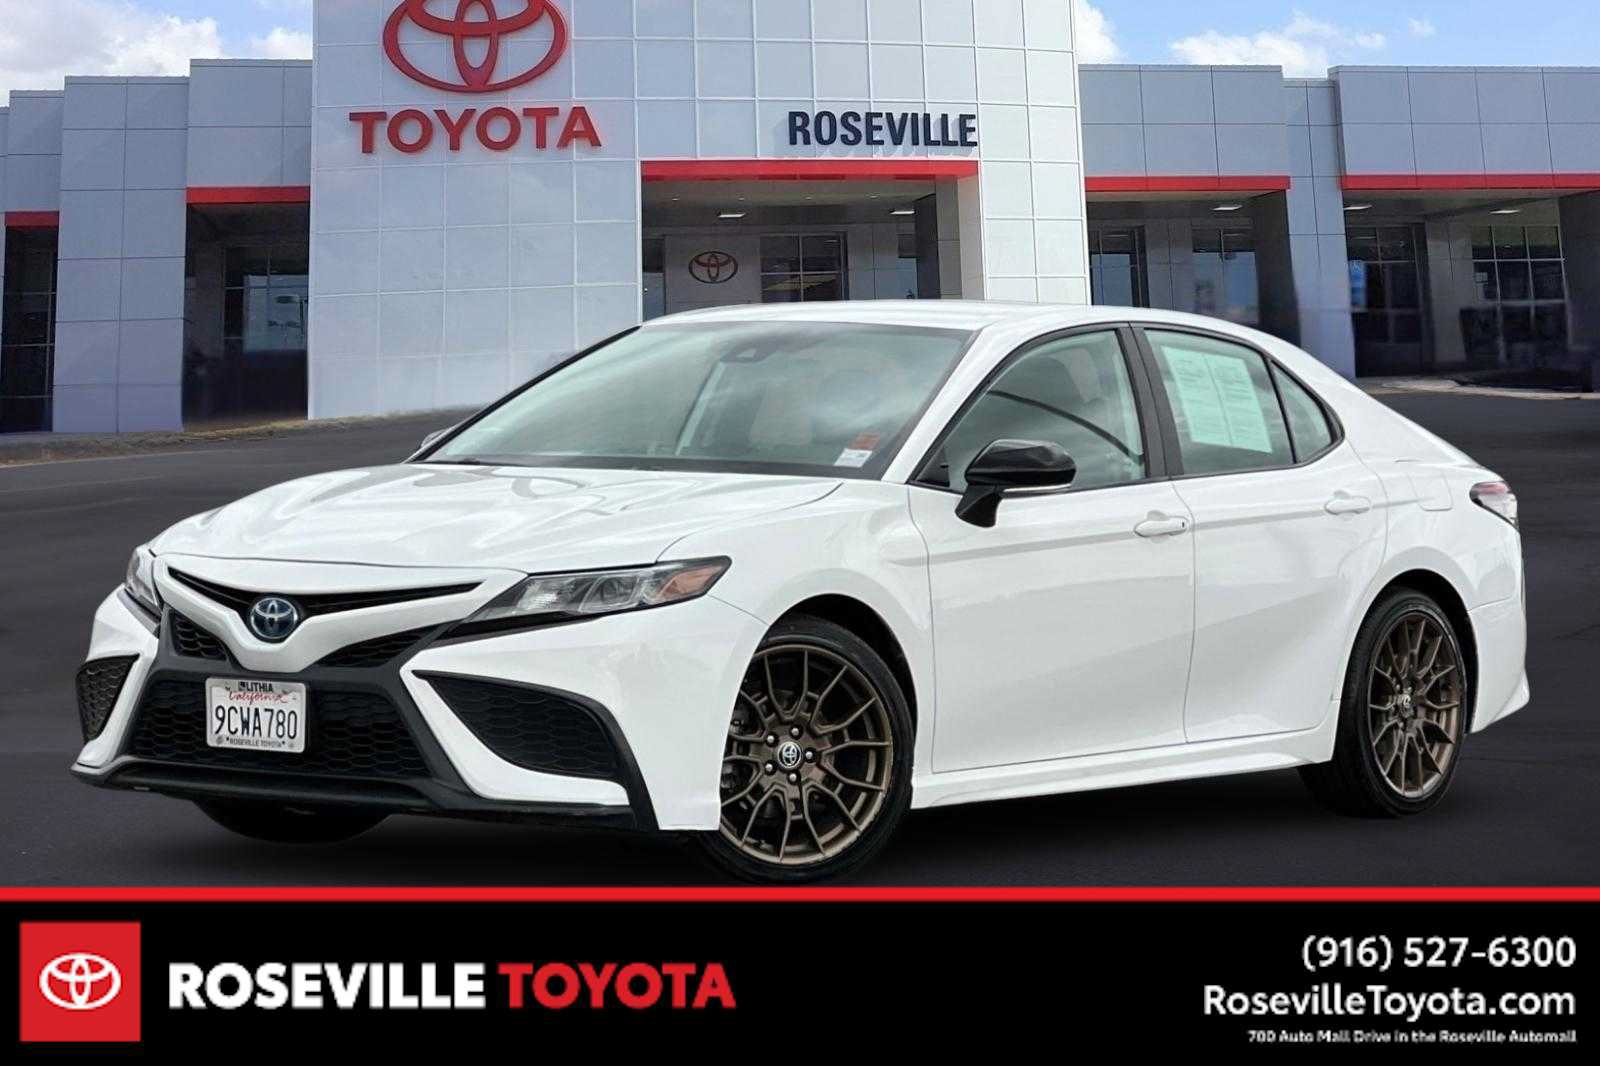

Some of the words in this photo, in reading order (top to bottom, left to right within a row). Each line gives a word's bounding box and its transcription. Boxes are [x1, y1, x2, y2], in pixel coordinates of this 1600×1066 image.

[349, 106, 602, 154] TOYOTA
[788, 110, 978, 147] ROSEVILLE
[229, 691, 289, 705] California
[246, 682, 274, 692] LITHIA
[215, 705, 298, 740] 9CWA780
